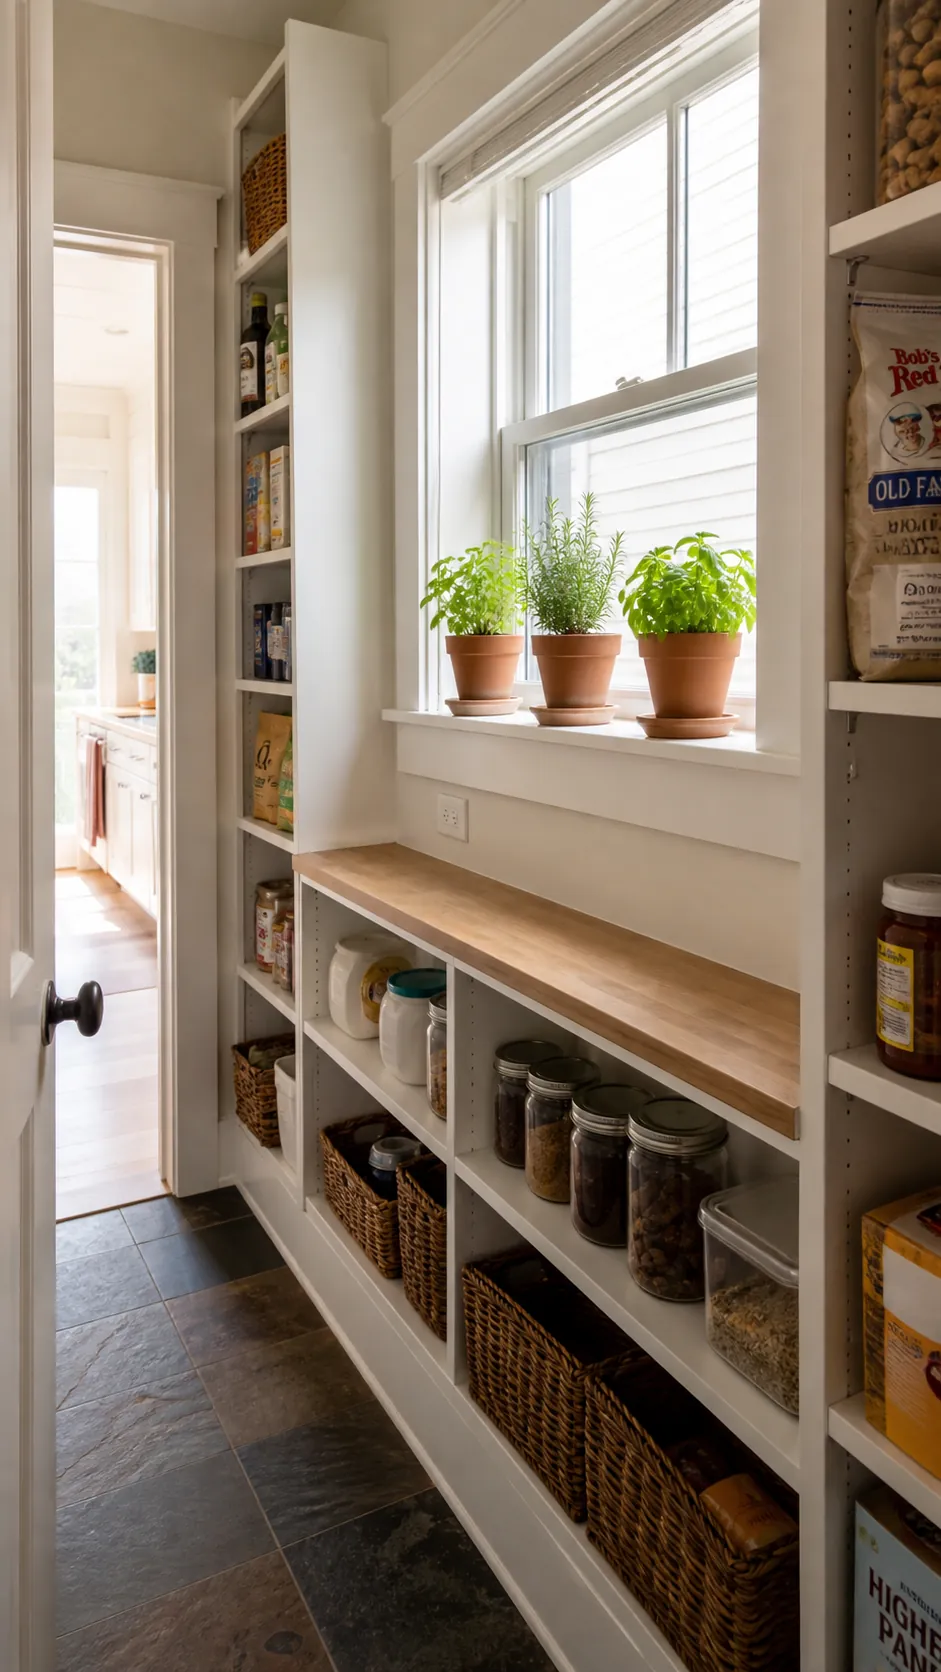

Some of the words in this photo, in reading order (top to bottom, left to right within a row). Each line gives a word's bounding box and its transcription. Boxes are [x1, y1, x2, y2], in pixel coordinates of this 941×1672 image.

[890, 348, 940, 365] Bob's
[888, 365, 939, 397] Red
[876, 478, 912, 501] OLD
[916, 475, 941, 498] FA
[879, 1612, 940, 1672] PAN
